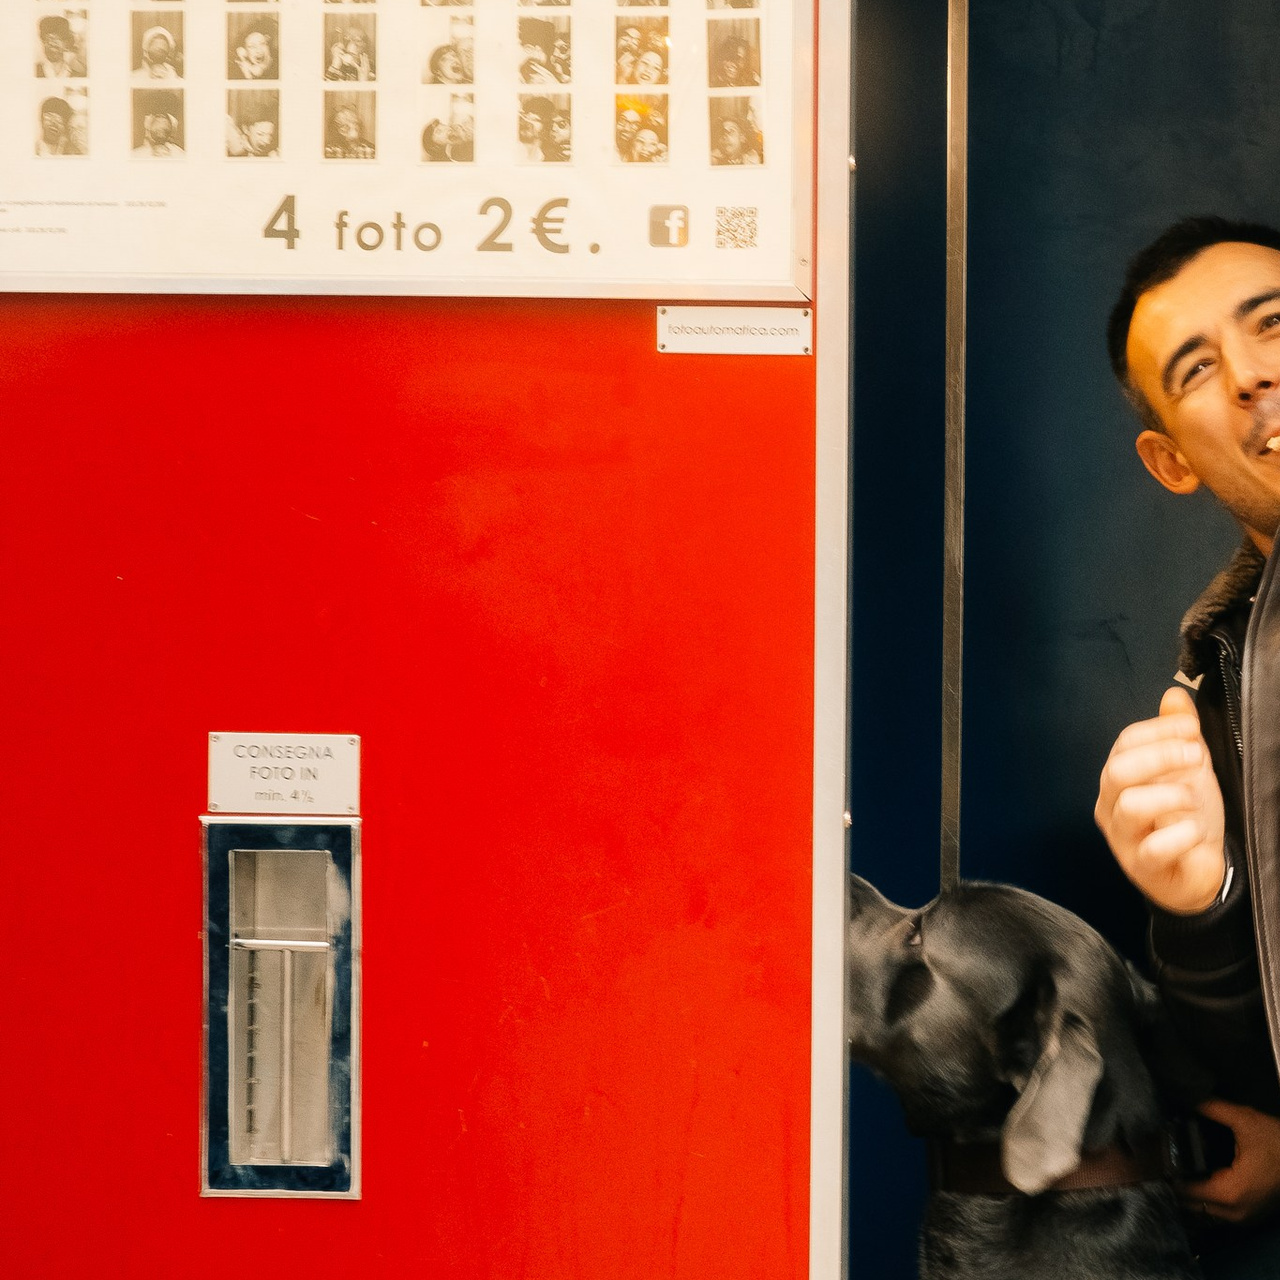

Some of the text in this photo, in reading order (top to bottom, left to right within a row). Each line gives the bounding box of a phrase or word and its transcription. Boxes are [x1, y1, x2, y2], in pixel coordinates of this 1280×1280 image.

[261, 195, 301, 251] 4
[333, 210, 444, 254] foto
[667, 324, 800, 337] fotoautomatica.com
[233, 744, 335, 760] CONSEGNA
[250, 766, 318, 781] FOTO IN
